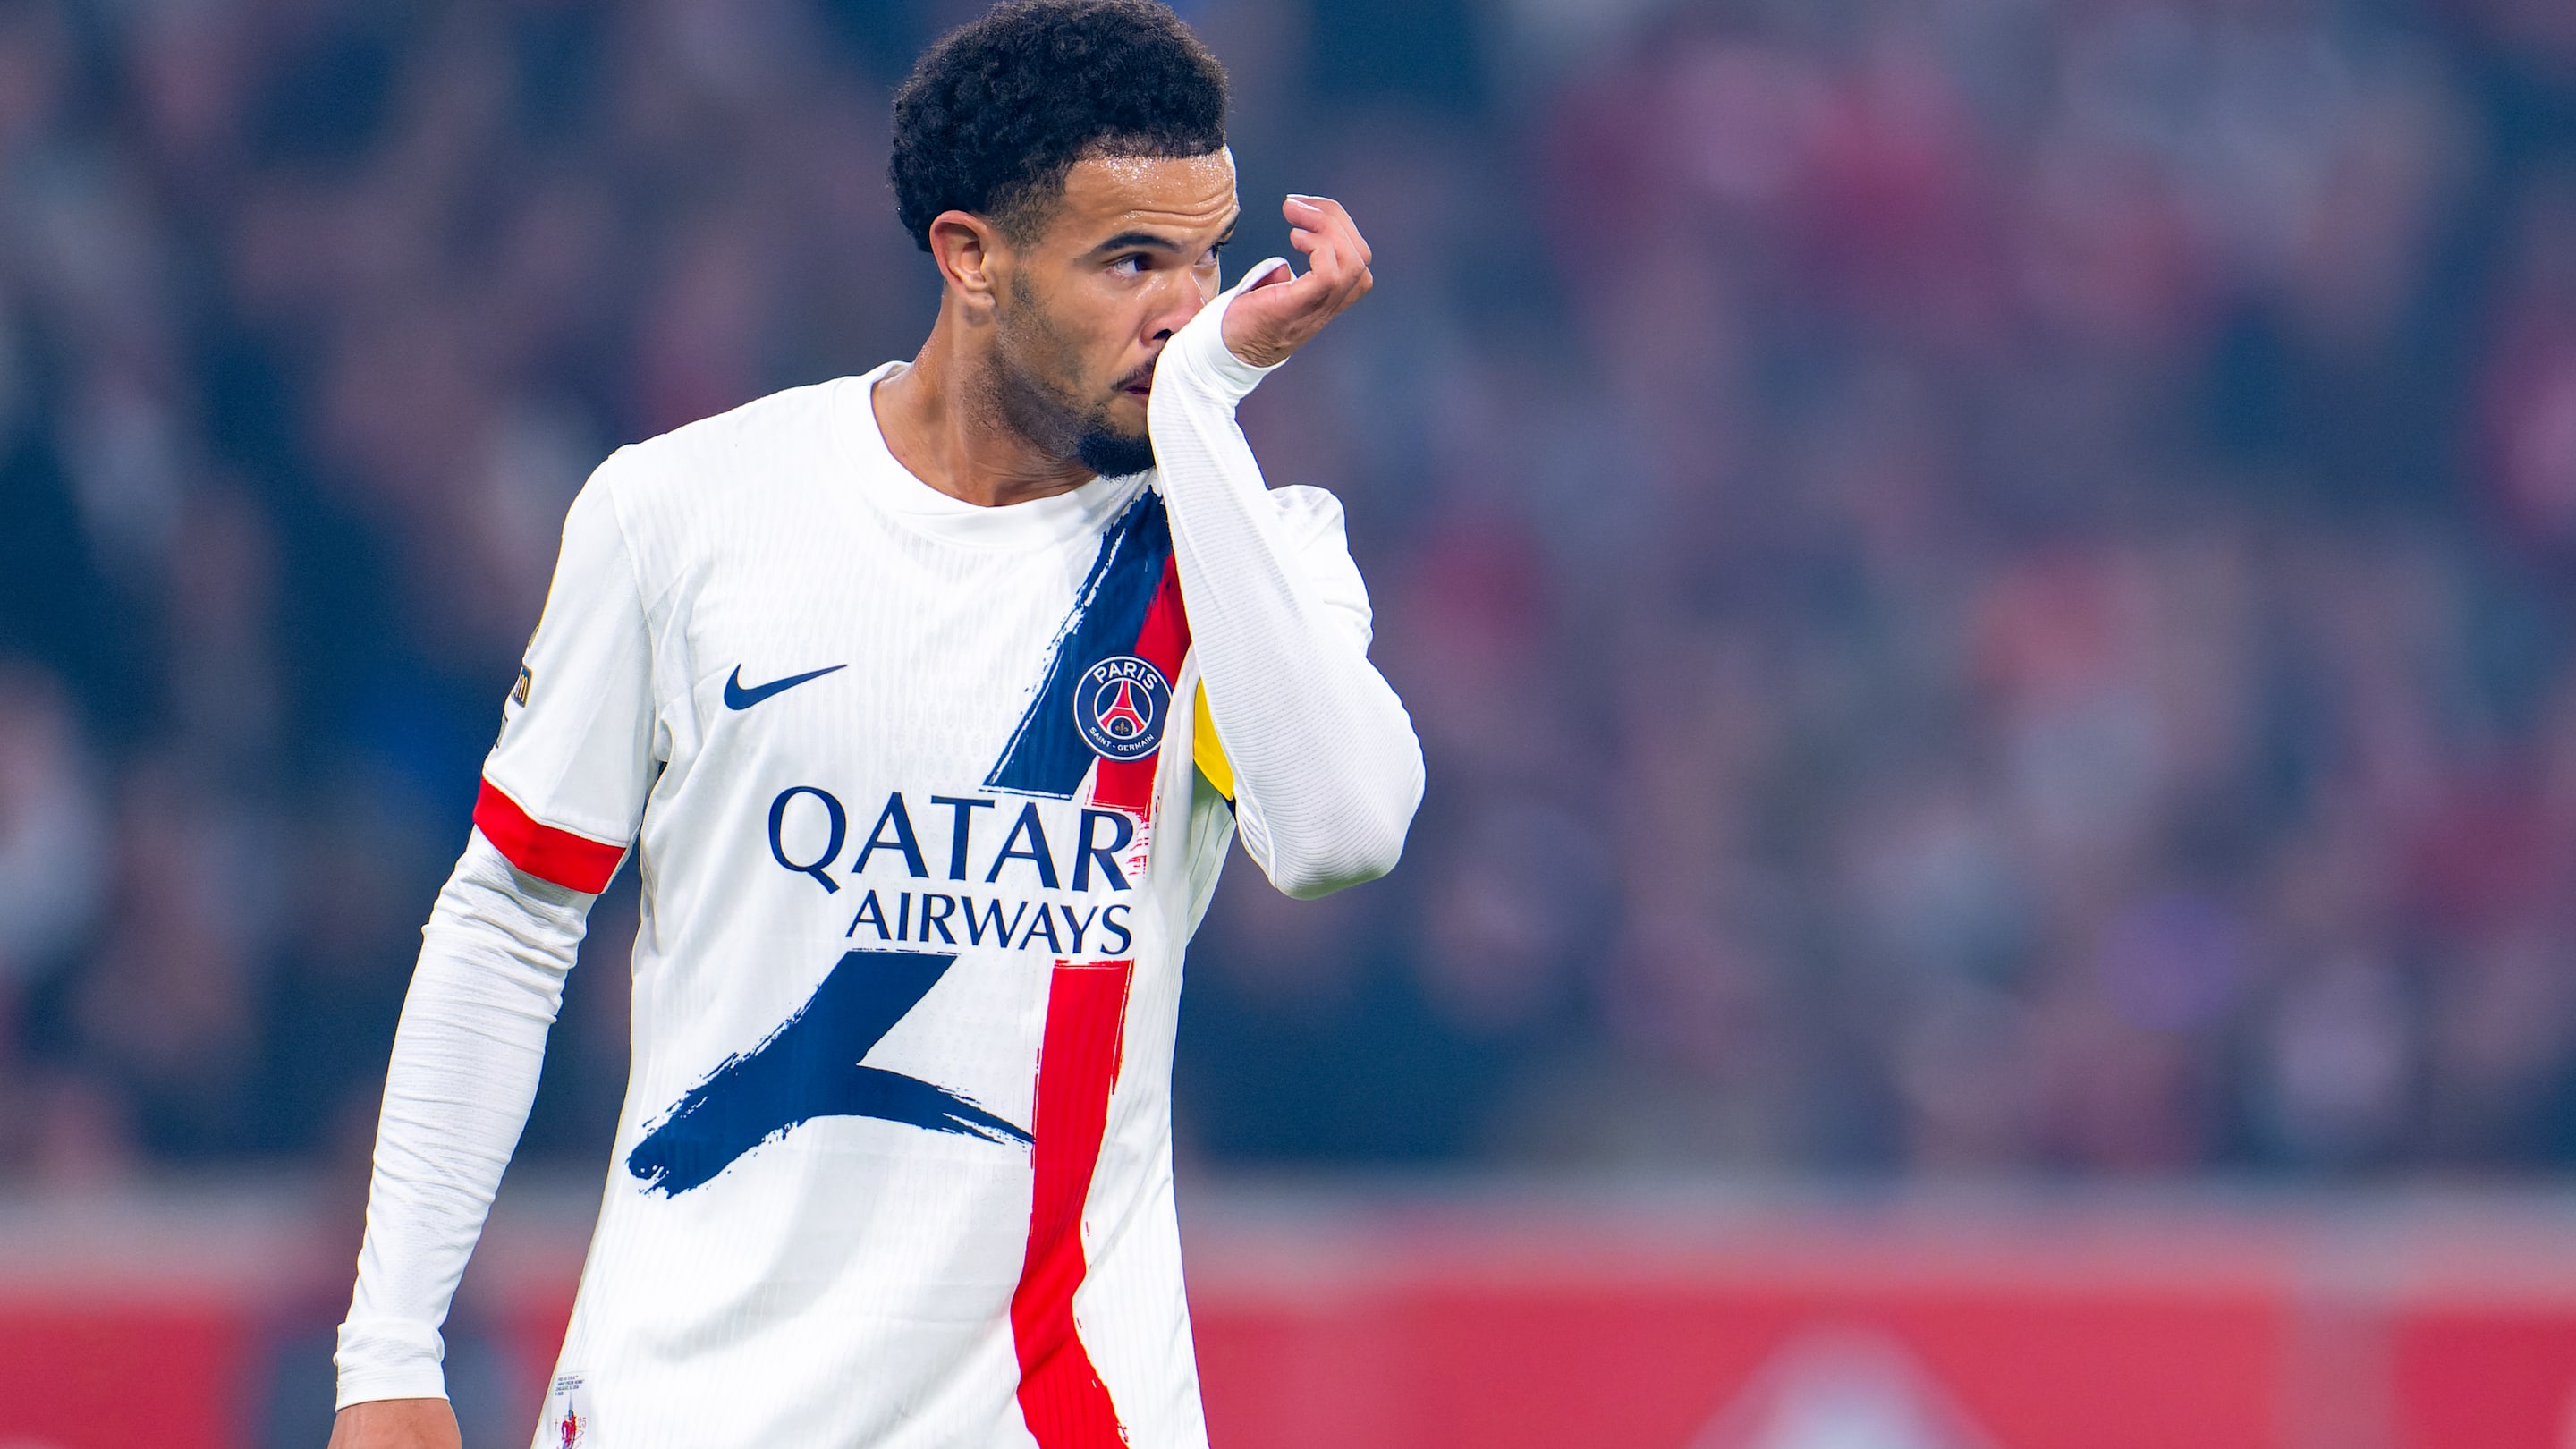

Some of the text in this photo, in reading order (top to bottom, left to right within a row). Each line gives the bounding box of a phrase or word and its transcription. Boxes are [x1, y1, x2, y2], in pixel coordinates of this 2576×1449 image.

[1092, 661, 1158, 691] PARIS
[767, 785, 1134, 894] QATAR
[844, 889, 1132, 956] AIRWAYS
